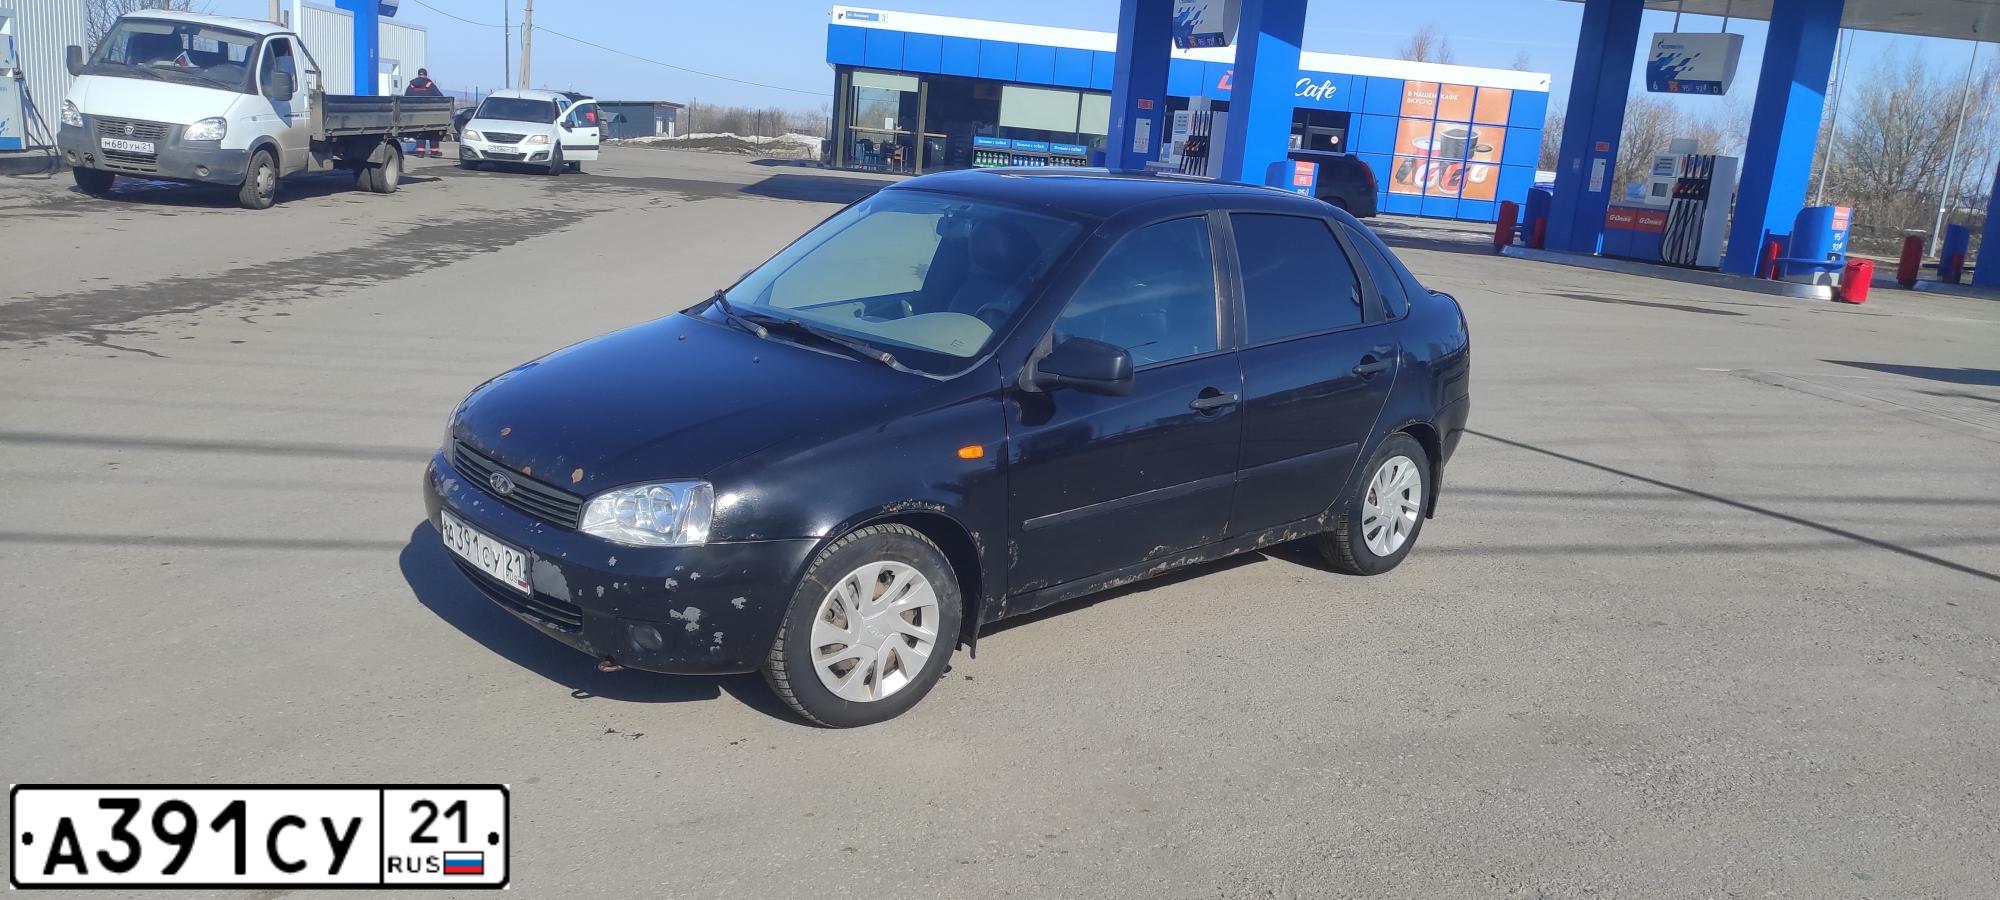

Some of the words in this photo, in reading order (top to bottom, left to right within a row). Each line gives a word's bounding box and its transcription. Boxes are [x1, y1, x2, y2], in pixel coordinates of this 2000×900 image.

[1295, 77, 1337, 101] Cafe
[448, 523, 500, 573] А391СУ
[505, 550, 522, 577] 21
[505, 571, 518, 584] RUS
